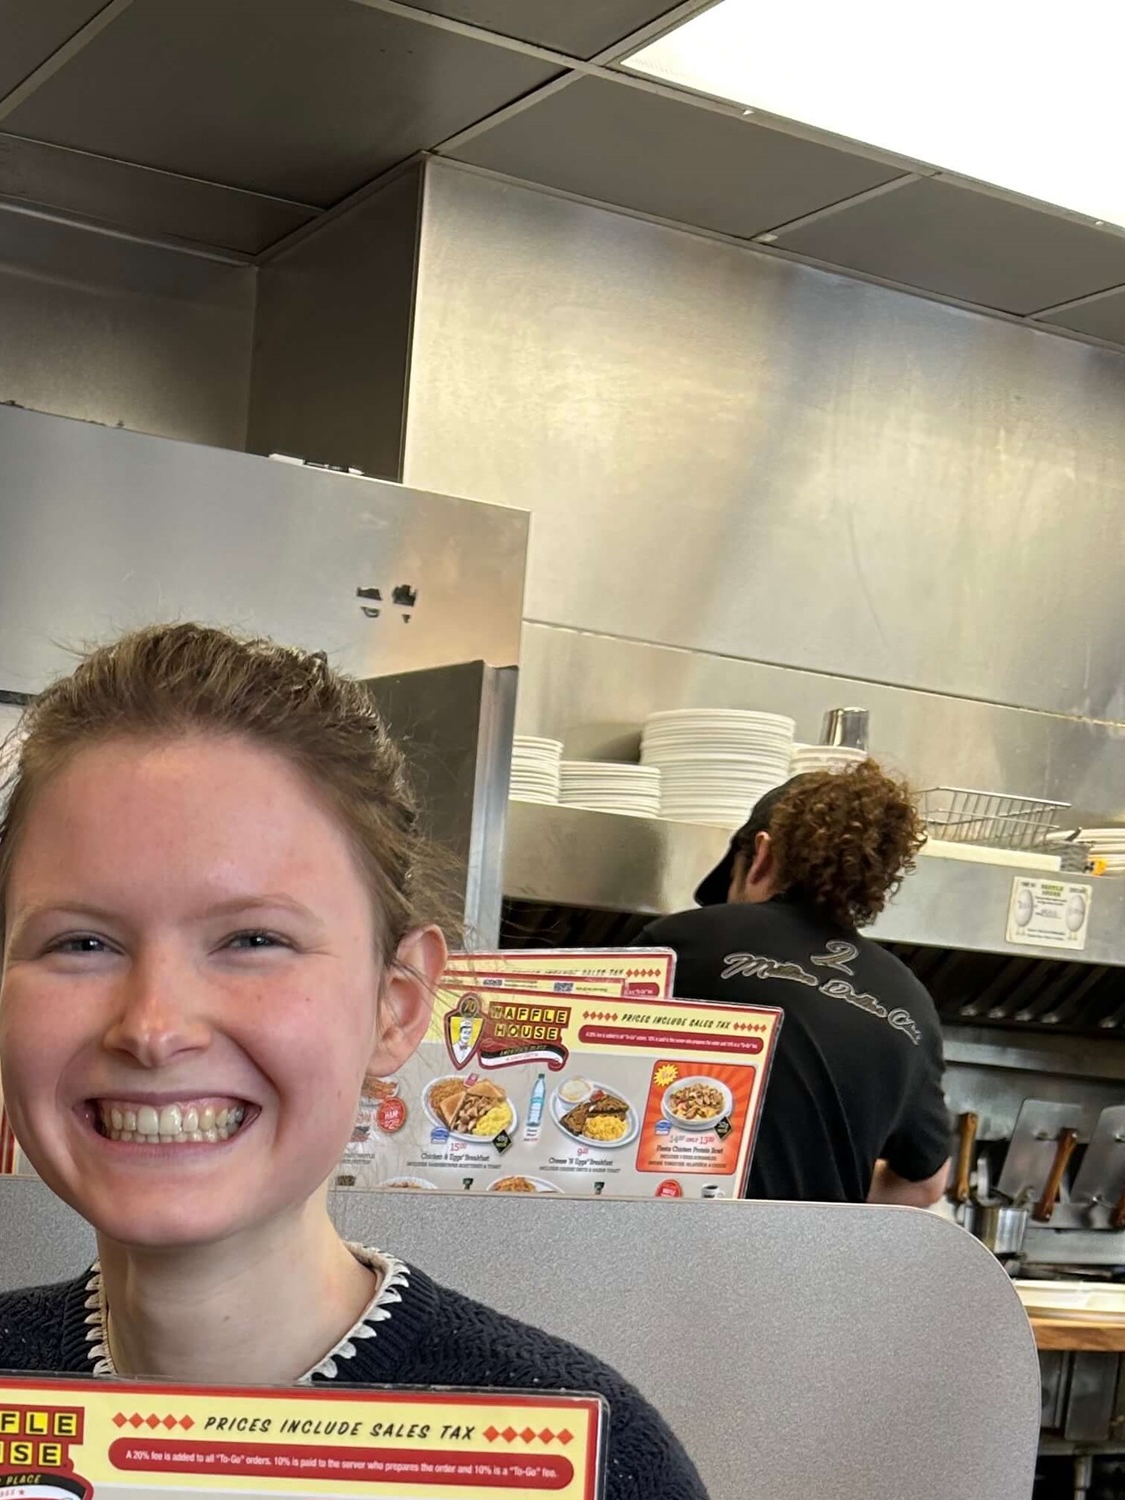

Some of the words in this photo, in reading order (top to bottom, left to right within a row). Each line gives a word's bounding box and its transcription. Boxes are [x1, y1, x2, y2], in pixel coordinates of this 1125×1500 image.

[491, 1004, 567, 1024] WAFFLE
[495, 1023, 559, 1040] HOUSE
[204, 1416, 272, 1433] PRICES
[280, 1418, 362, 1436] INCLUDE
[369, 1422, 431, 1439] SALES
[440, 1424, 475, 1440] TAX
[6, 1472, 42, 1486] PLACE
